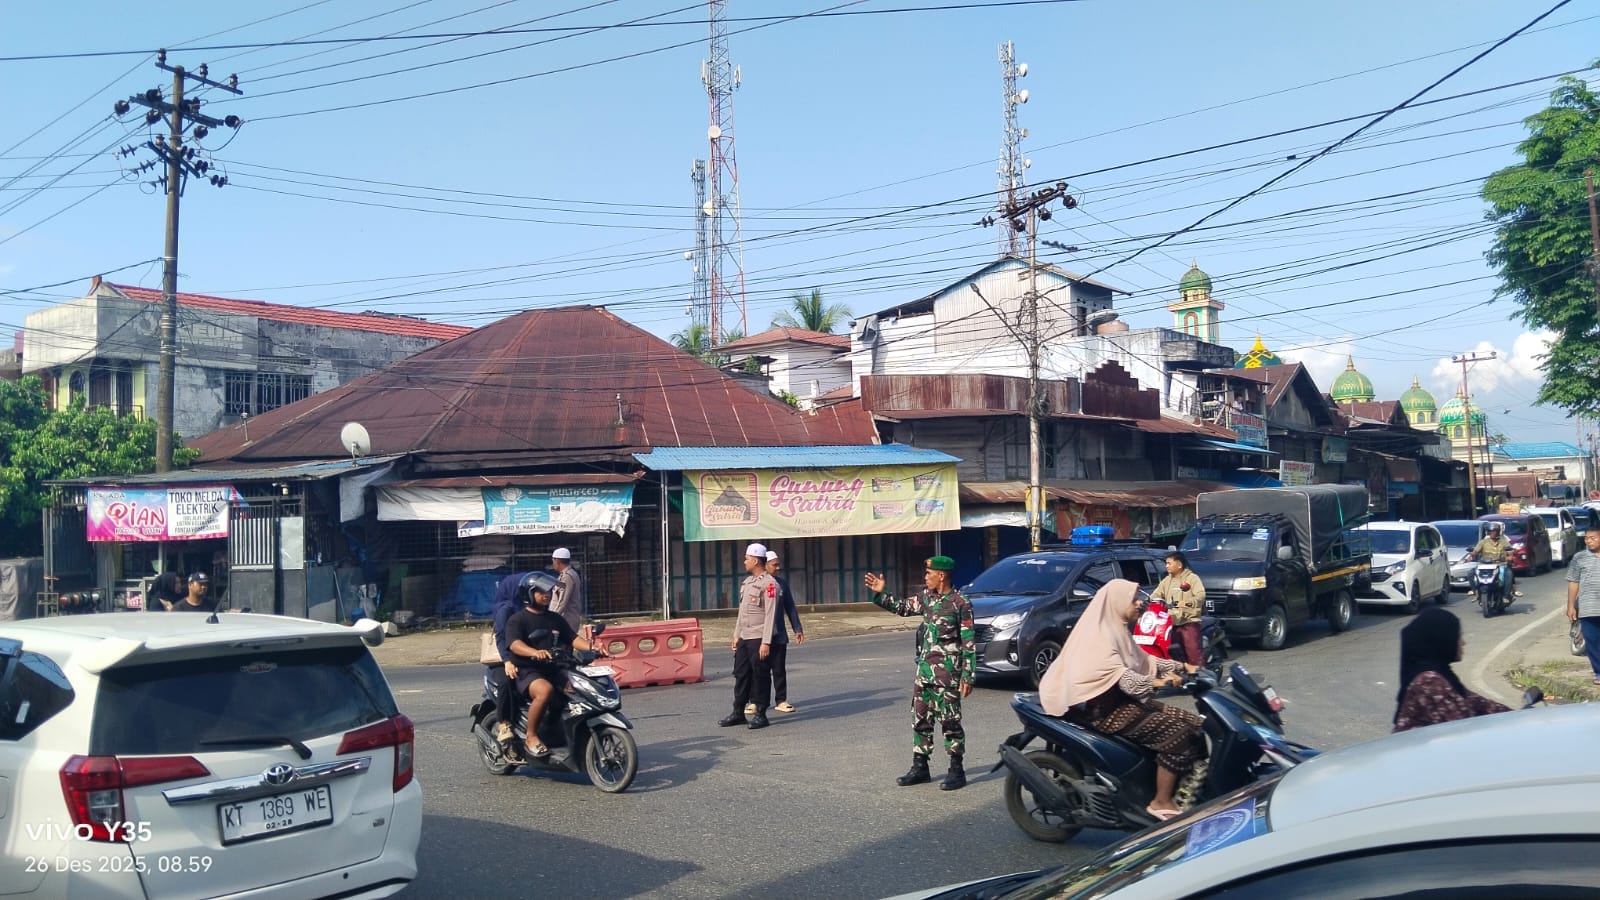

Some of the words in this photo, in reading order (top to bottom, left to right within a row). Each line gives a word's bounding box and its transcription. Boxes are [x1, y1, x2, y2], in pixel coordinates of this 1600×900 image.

[168, 491, 192, 503] TOKO
[195, 490, 224, 503] MELDA
[769, 475, 865, 507] Gunung
[176, 503, 219, 515] ELEKTRIK
[777, 495, 857, 517] Satria
[225, 805, 243, 828] KT
[260, 797, 294, 820] 1369
[304, 790, 326, 812] WE
